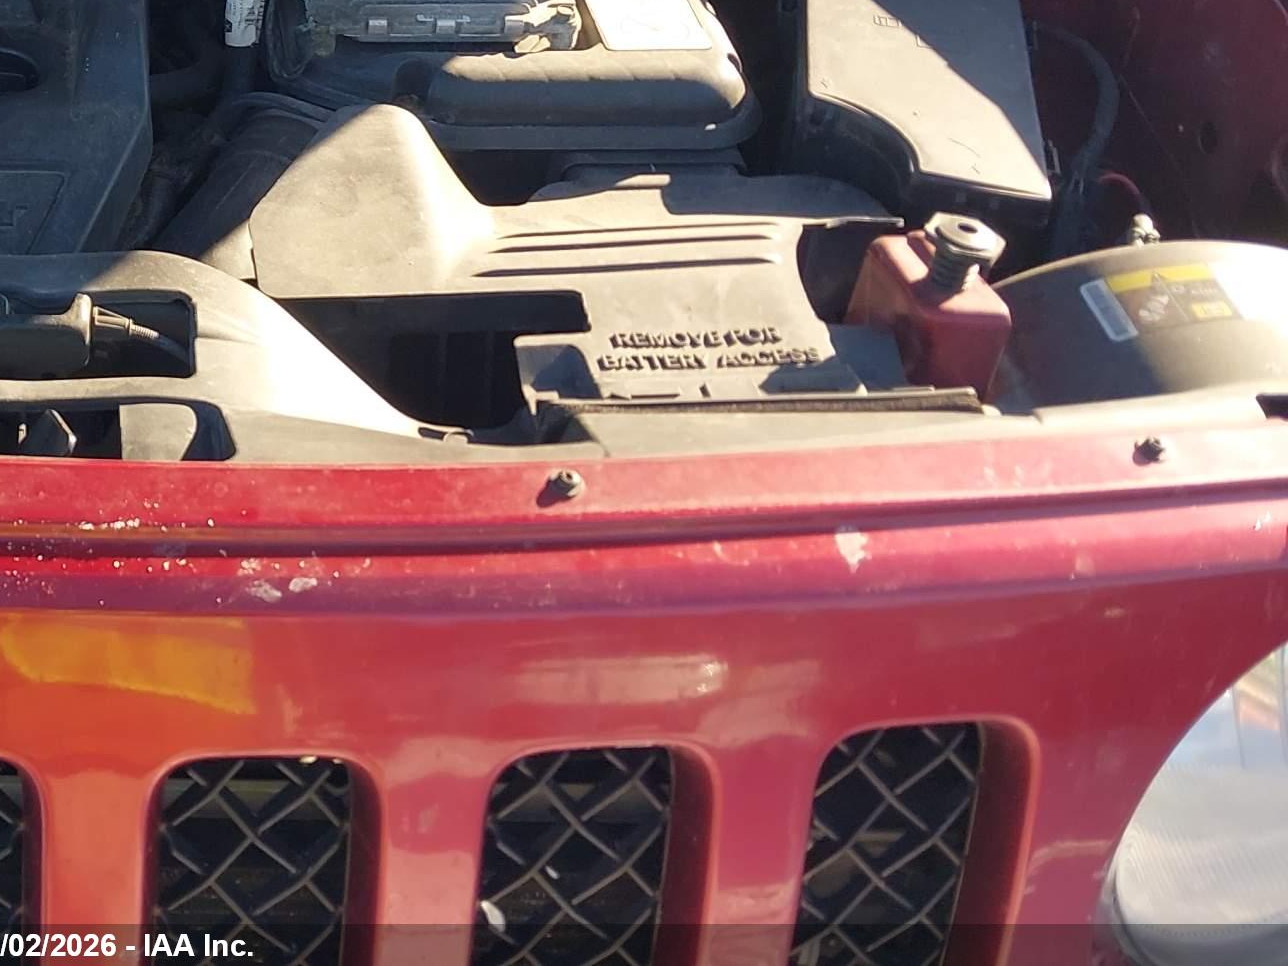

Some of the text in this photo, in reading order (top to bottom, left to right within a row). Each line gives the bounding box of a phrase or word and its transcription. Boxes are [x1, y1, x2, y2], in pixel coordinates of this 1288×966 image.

[609, 327, 782, 349] REMOVE FOR
[597, 347, 819, 371] BATTERY ACCESS
